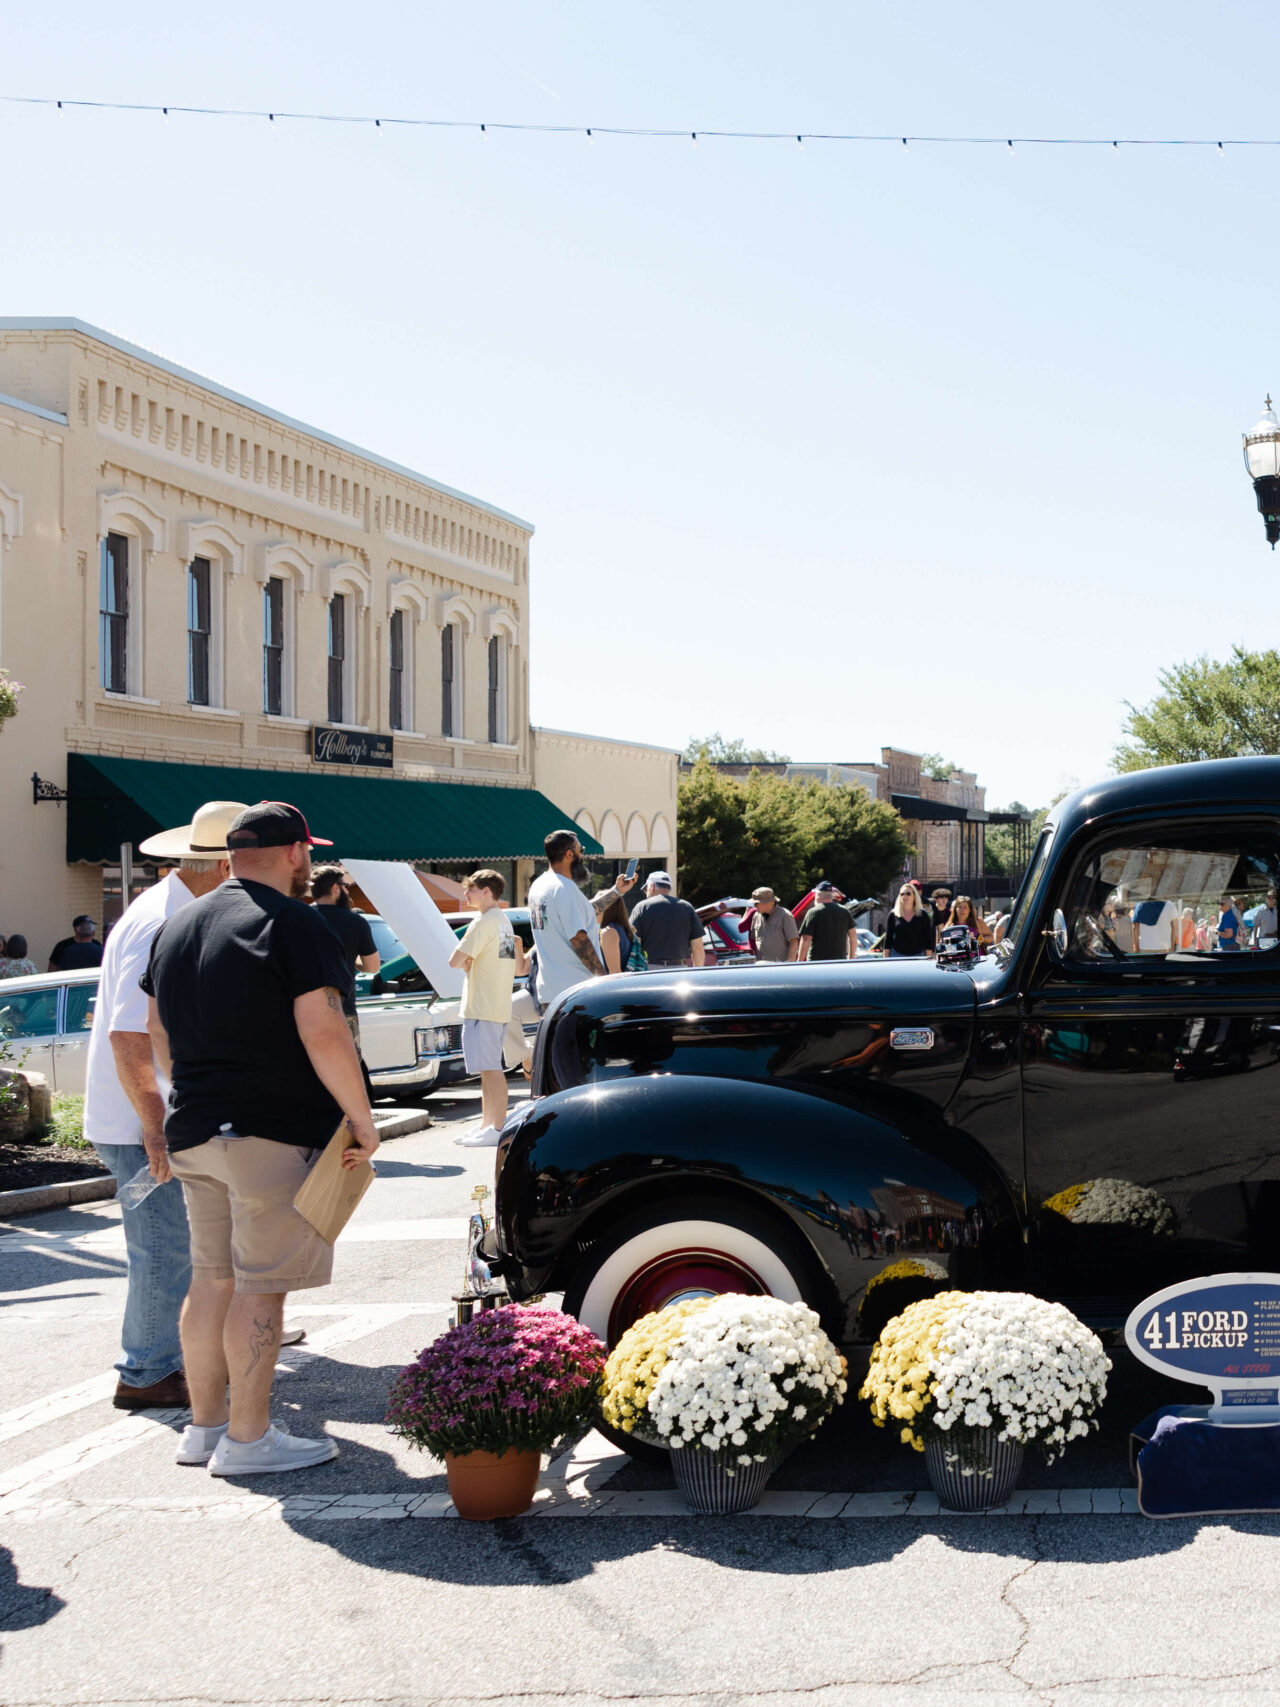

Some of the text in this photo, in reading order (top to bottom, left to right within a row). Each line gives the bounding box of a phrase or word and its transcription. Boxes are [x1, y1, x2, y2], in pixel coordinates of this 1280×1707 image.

[315, 730, 368, 764] Hollberg's
[895, 1032, 927, 1045] Ford
[1143, 1311, 1181, 1350] 41
[1181, 1310, 1248, 1332] FORD
[1181, 1331, 1249, 1349] PICKUP
[1241, 1363, 1271, 1374] STEEL
